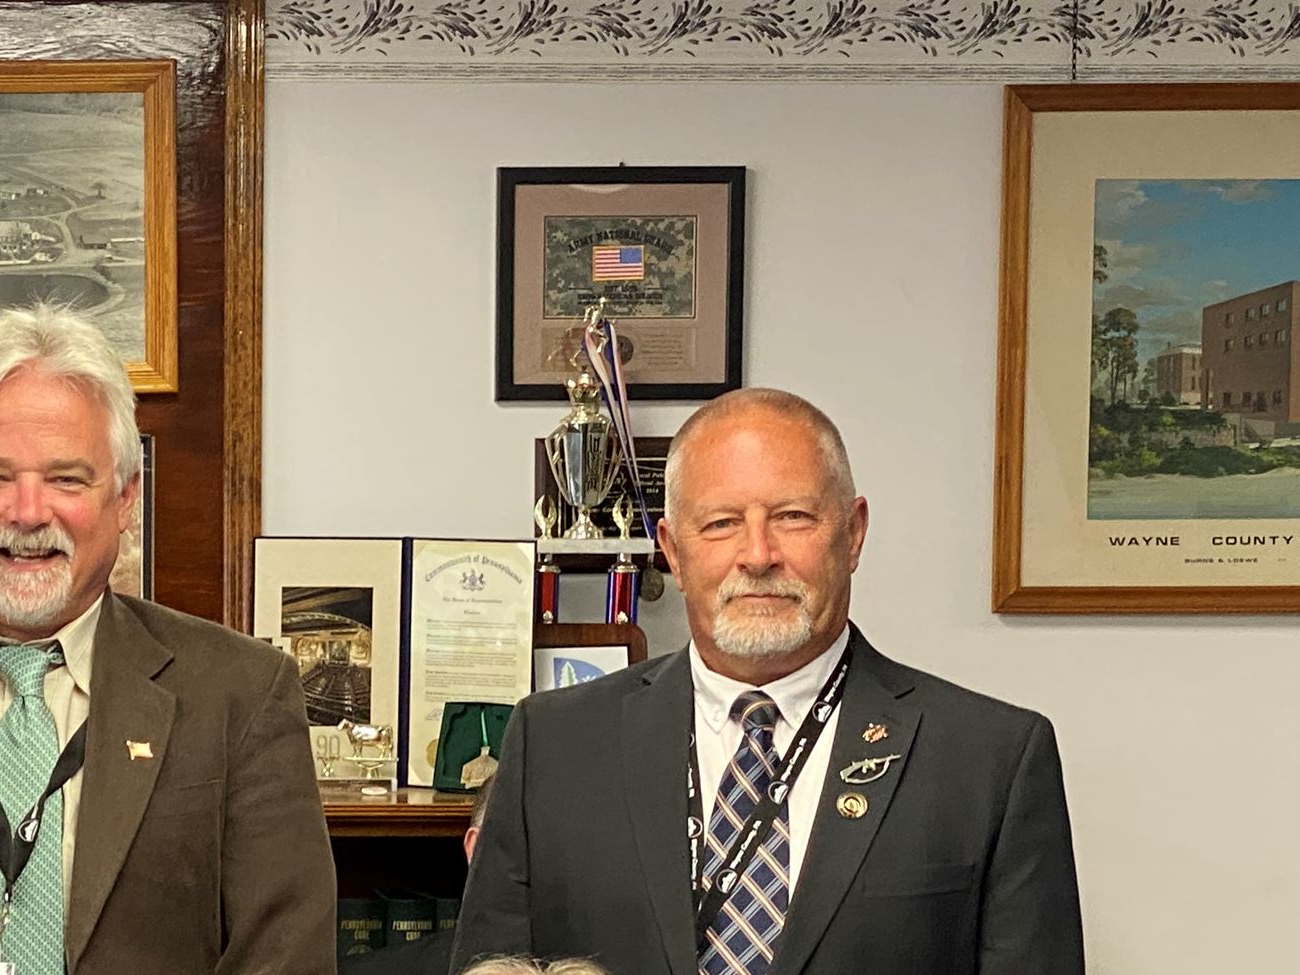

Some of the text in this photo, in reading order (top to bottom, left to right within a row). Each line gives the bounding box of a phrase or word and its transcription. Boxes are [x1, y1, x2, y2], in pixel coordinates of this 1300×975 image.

[568, 233, 594, 253] ARMY
[597, 229, 642, 240] NATIONAL
[1109, 536, 1294, 546] WAYNE COUNTY
[317, 734, 340, 757] 90
